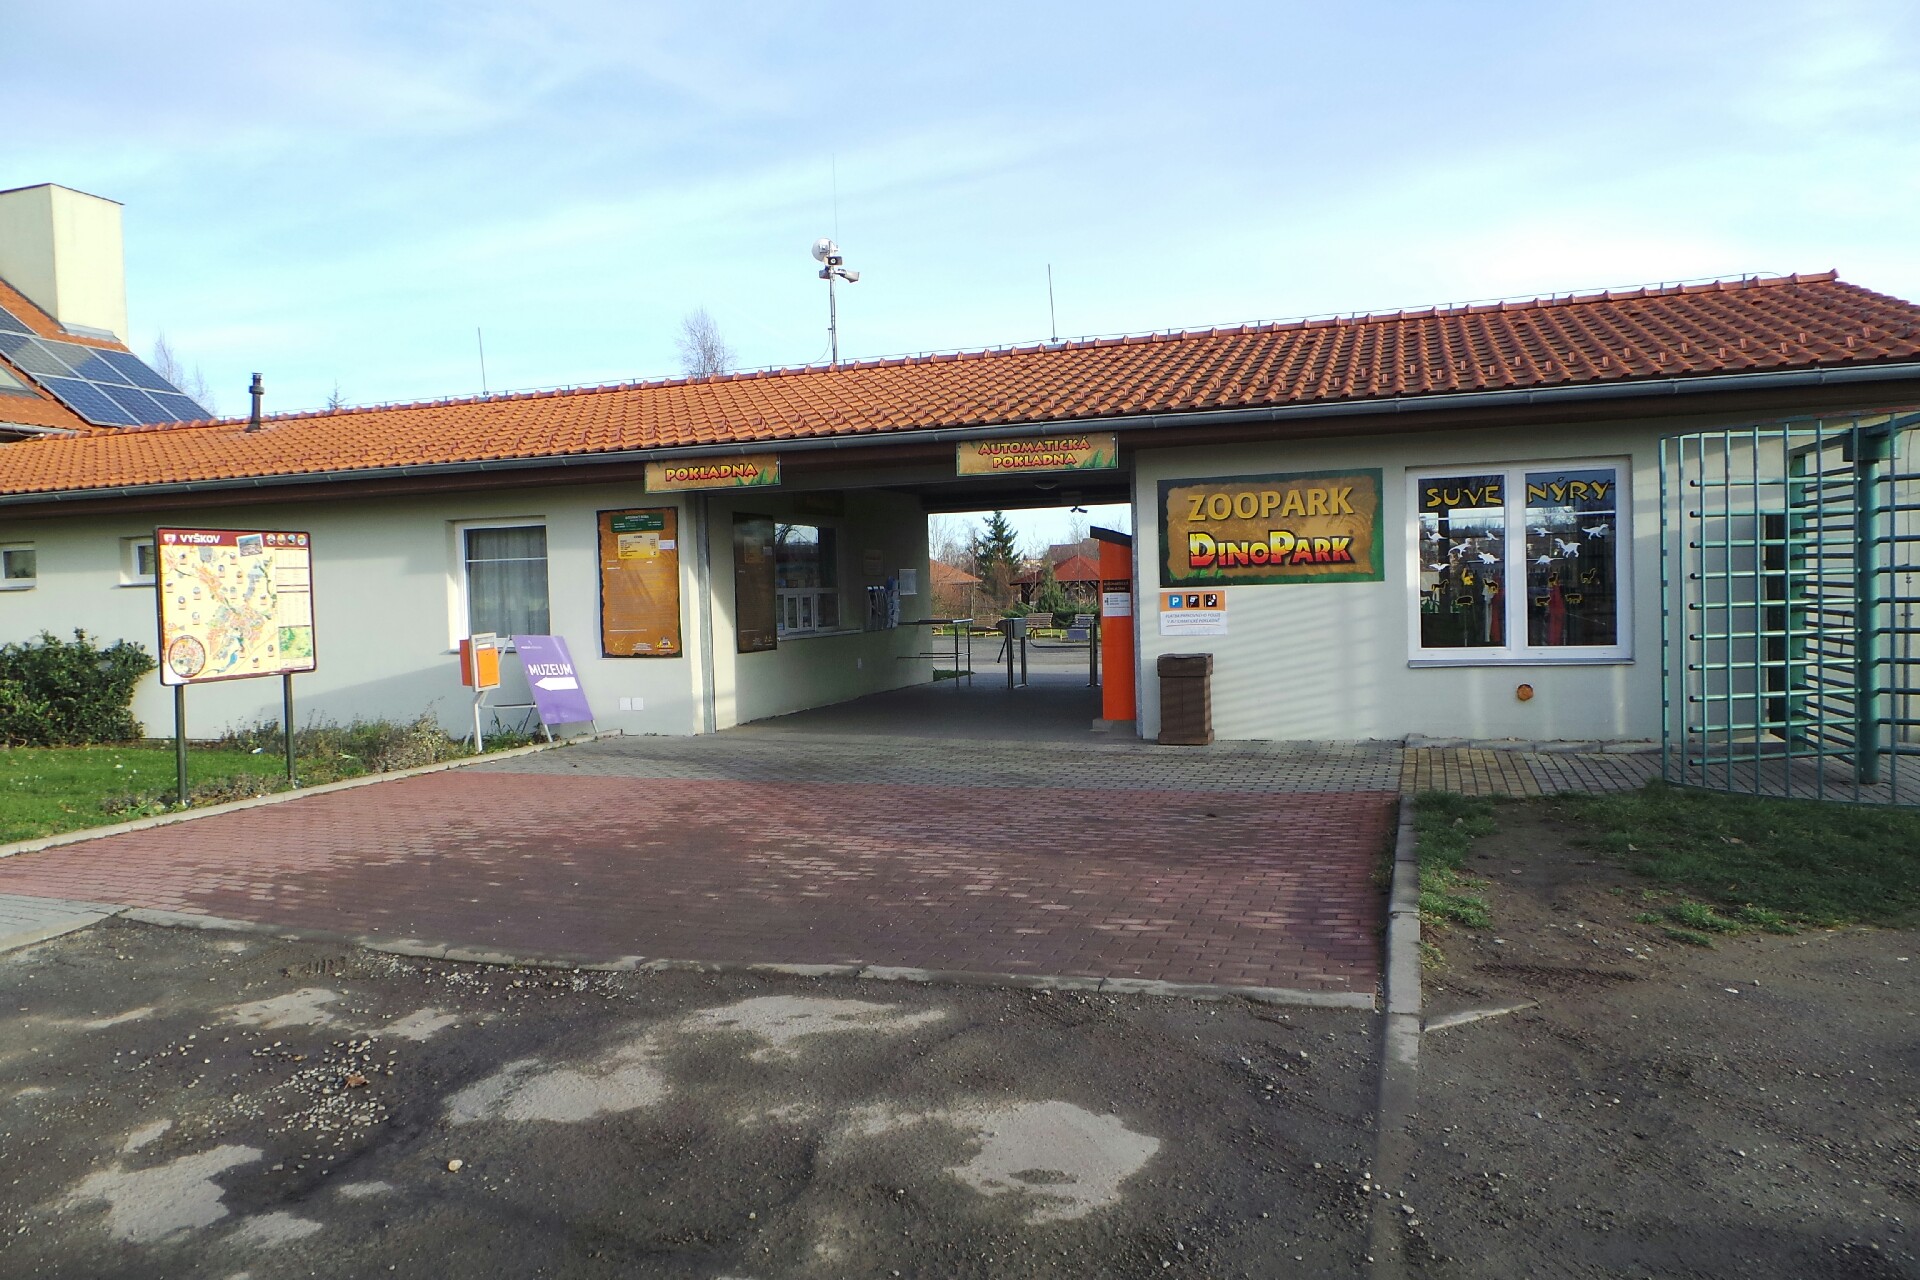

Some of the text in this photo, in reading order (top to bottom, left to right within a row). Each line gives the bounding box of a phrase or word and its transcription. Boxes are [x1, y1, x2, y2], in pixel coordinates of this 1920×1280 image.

[978, 436, 1091, 455] AUTOMATICKÁ
[992, 453, 1077, 468] POKLADNA
[665, 463, 758, 482] POKLADNA
[1426, 476, 1611, 507] SUVE NÝRY
[1187, 486, 1354, 521] ZOOPARK
[180, 533, 220, 544] VYŠKOV
[527, 663, 573, 676] MUZEUM
